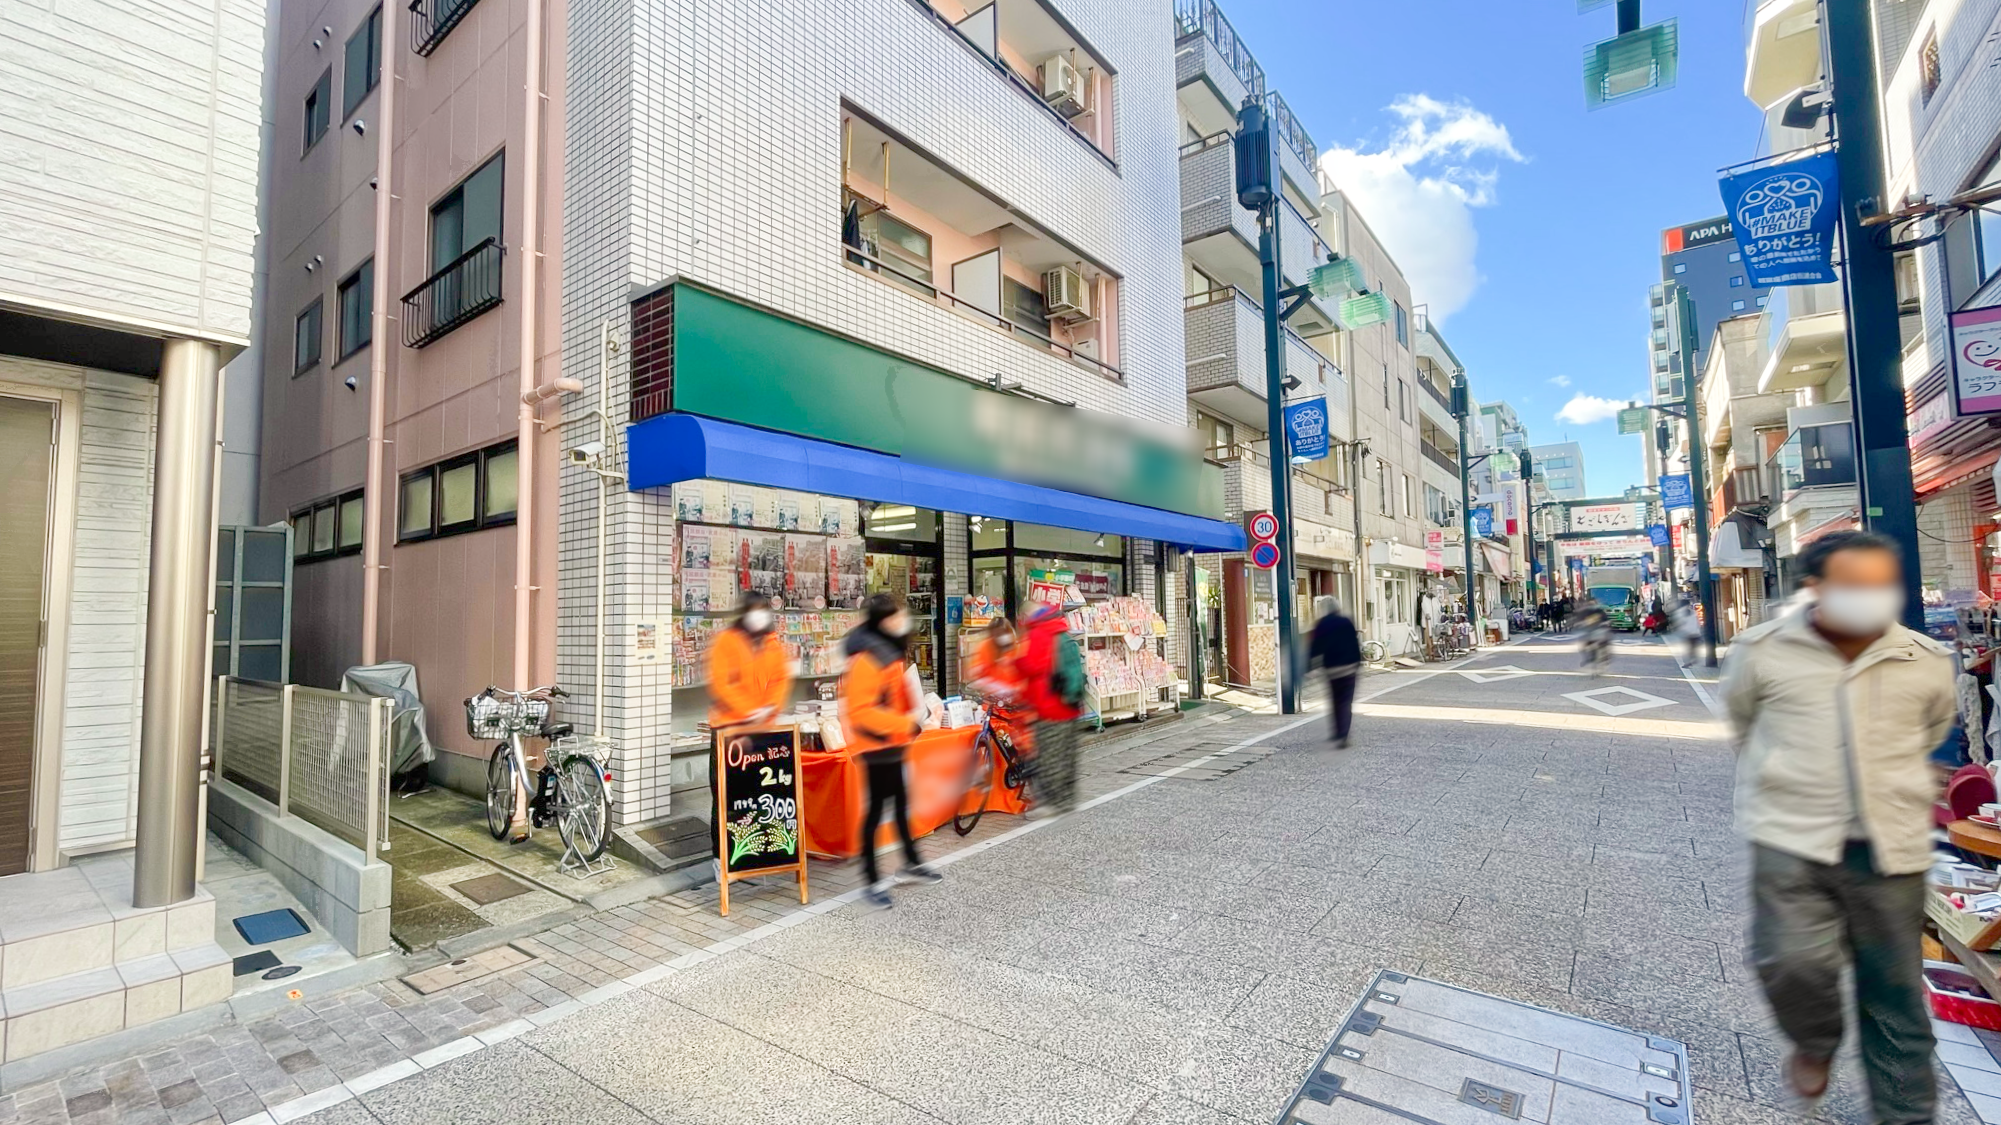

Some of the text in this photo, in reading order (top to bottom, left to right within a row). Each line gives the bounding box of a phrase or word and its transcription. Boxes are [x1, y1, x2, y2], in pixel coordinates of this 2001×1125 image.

[1752, 208, 1810, 228] #MAKE
[1754, 218, 1808, 237] ITBLUE
[1689, 226, 1719, 241] APA
[1744, 232, 1821, 256] ありがとう!
[1257, 521, 1272, 533] 30
[728, 740, 765, 771] Open
